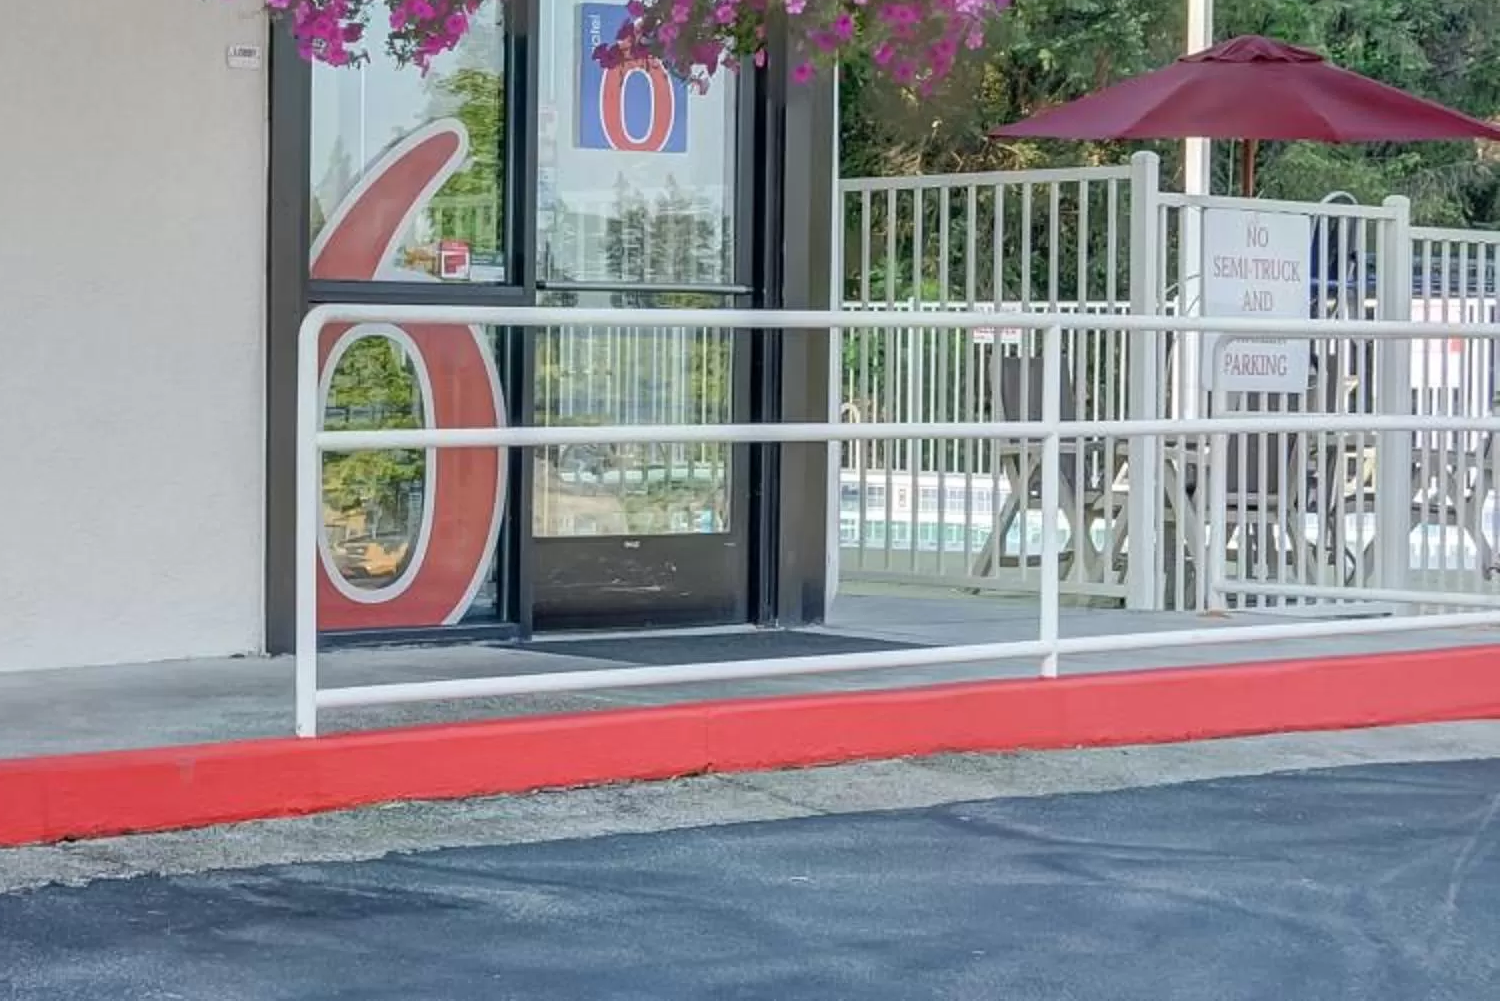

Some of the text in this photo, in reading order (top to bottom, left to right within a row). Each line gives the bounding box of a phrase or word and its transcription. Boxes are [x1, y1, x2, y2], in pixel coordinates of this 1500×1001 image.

[1246, 225, 1269, 248] NO
[1213, 257, 1300, 283] SEMI-TRUCK
[1241, 290, 1273, 312] AND
[310, 117, 508, 627] 6
[1224, 353, 1288, 376] PARKING
